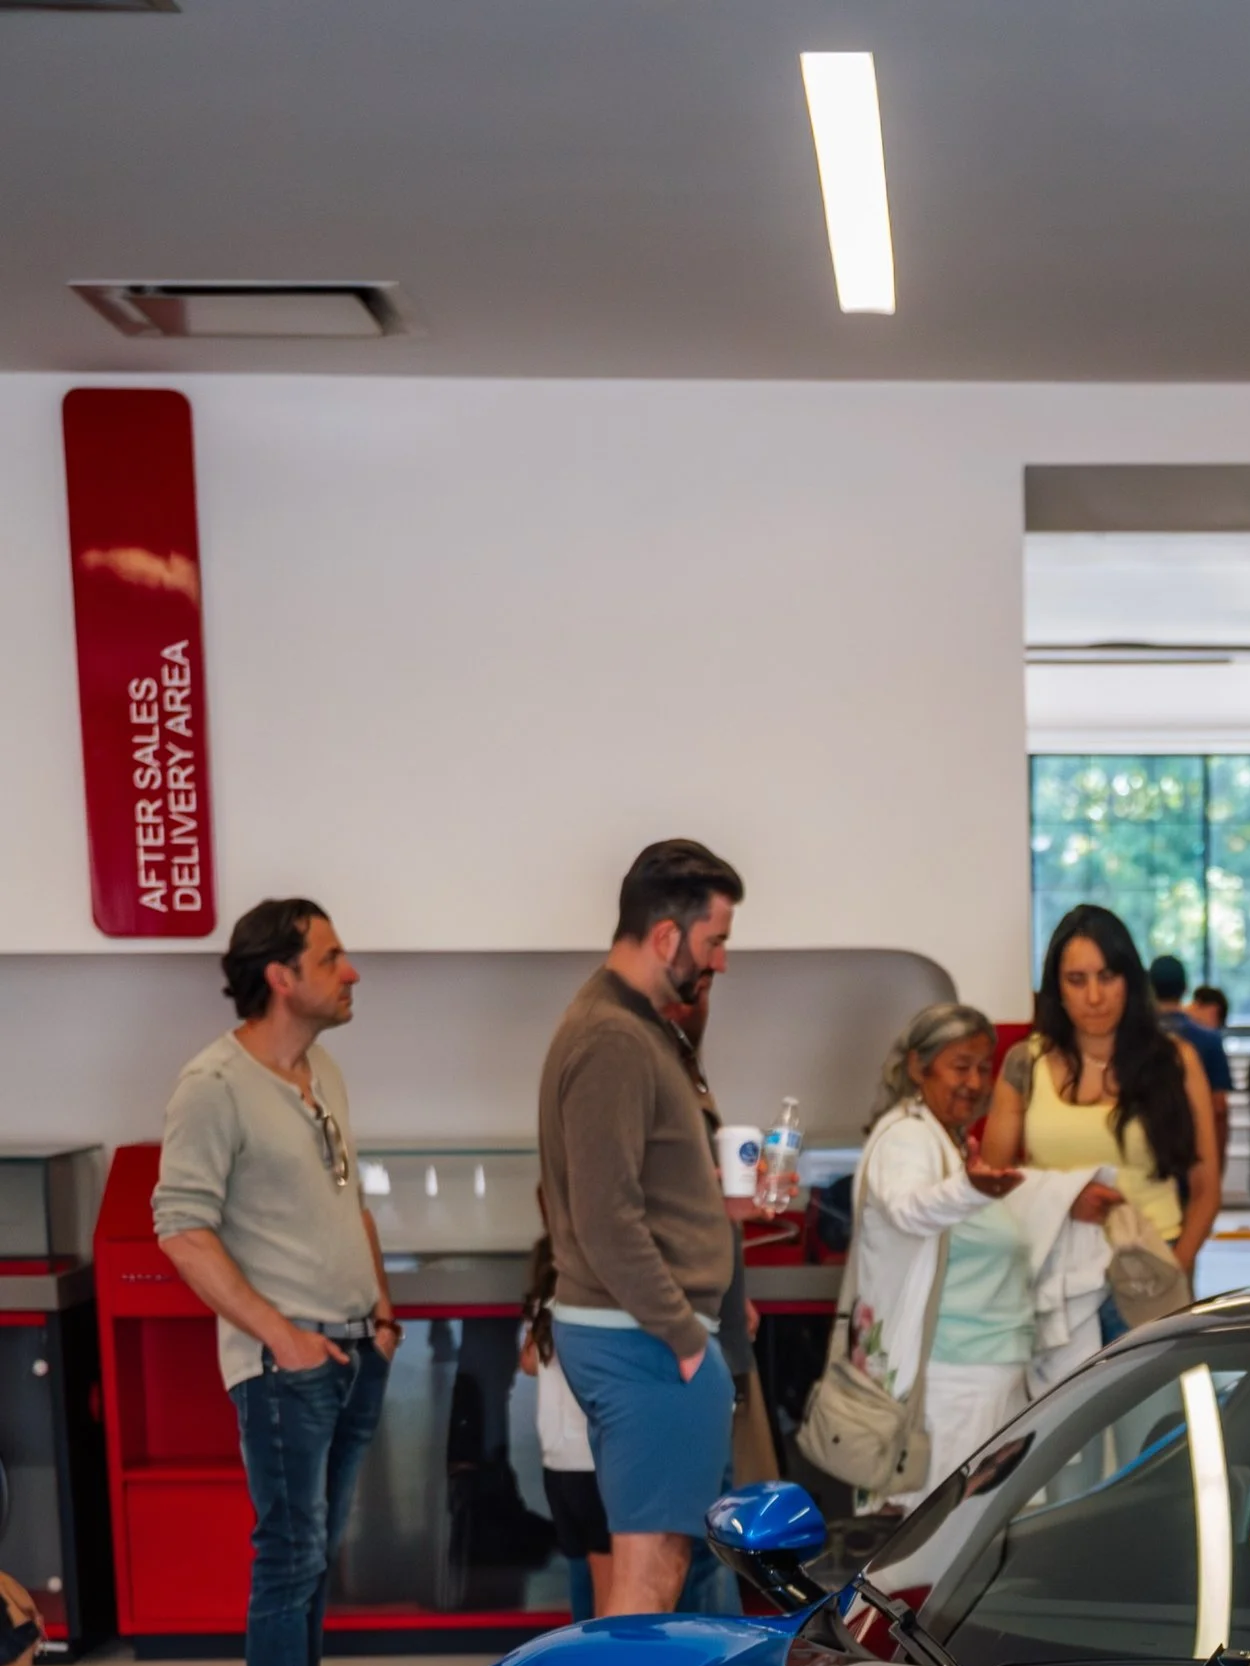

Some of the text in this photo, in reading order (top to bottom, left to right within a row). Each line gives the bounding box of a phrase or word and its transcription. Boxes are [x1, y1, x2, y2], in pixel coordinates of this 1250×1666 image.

[128, 676, 169, 913] AFTER SALES
[160, 639, 202, 912] DELIVERY AREA
